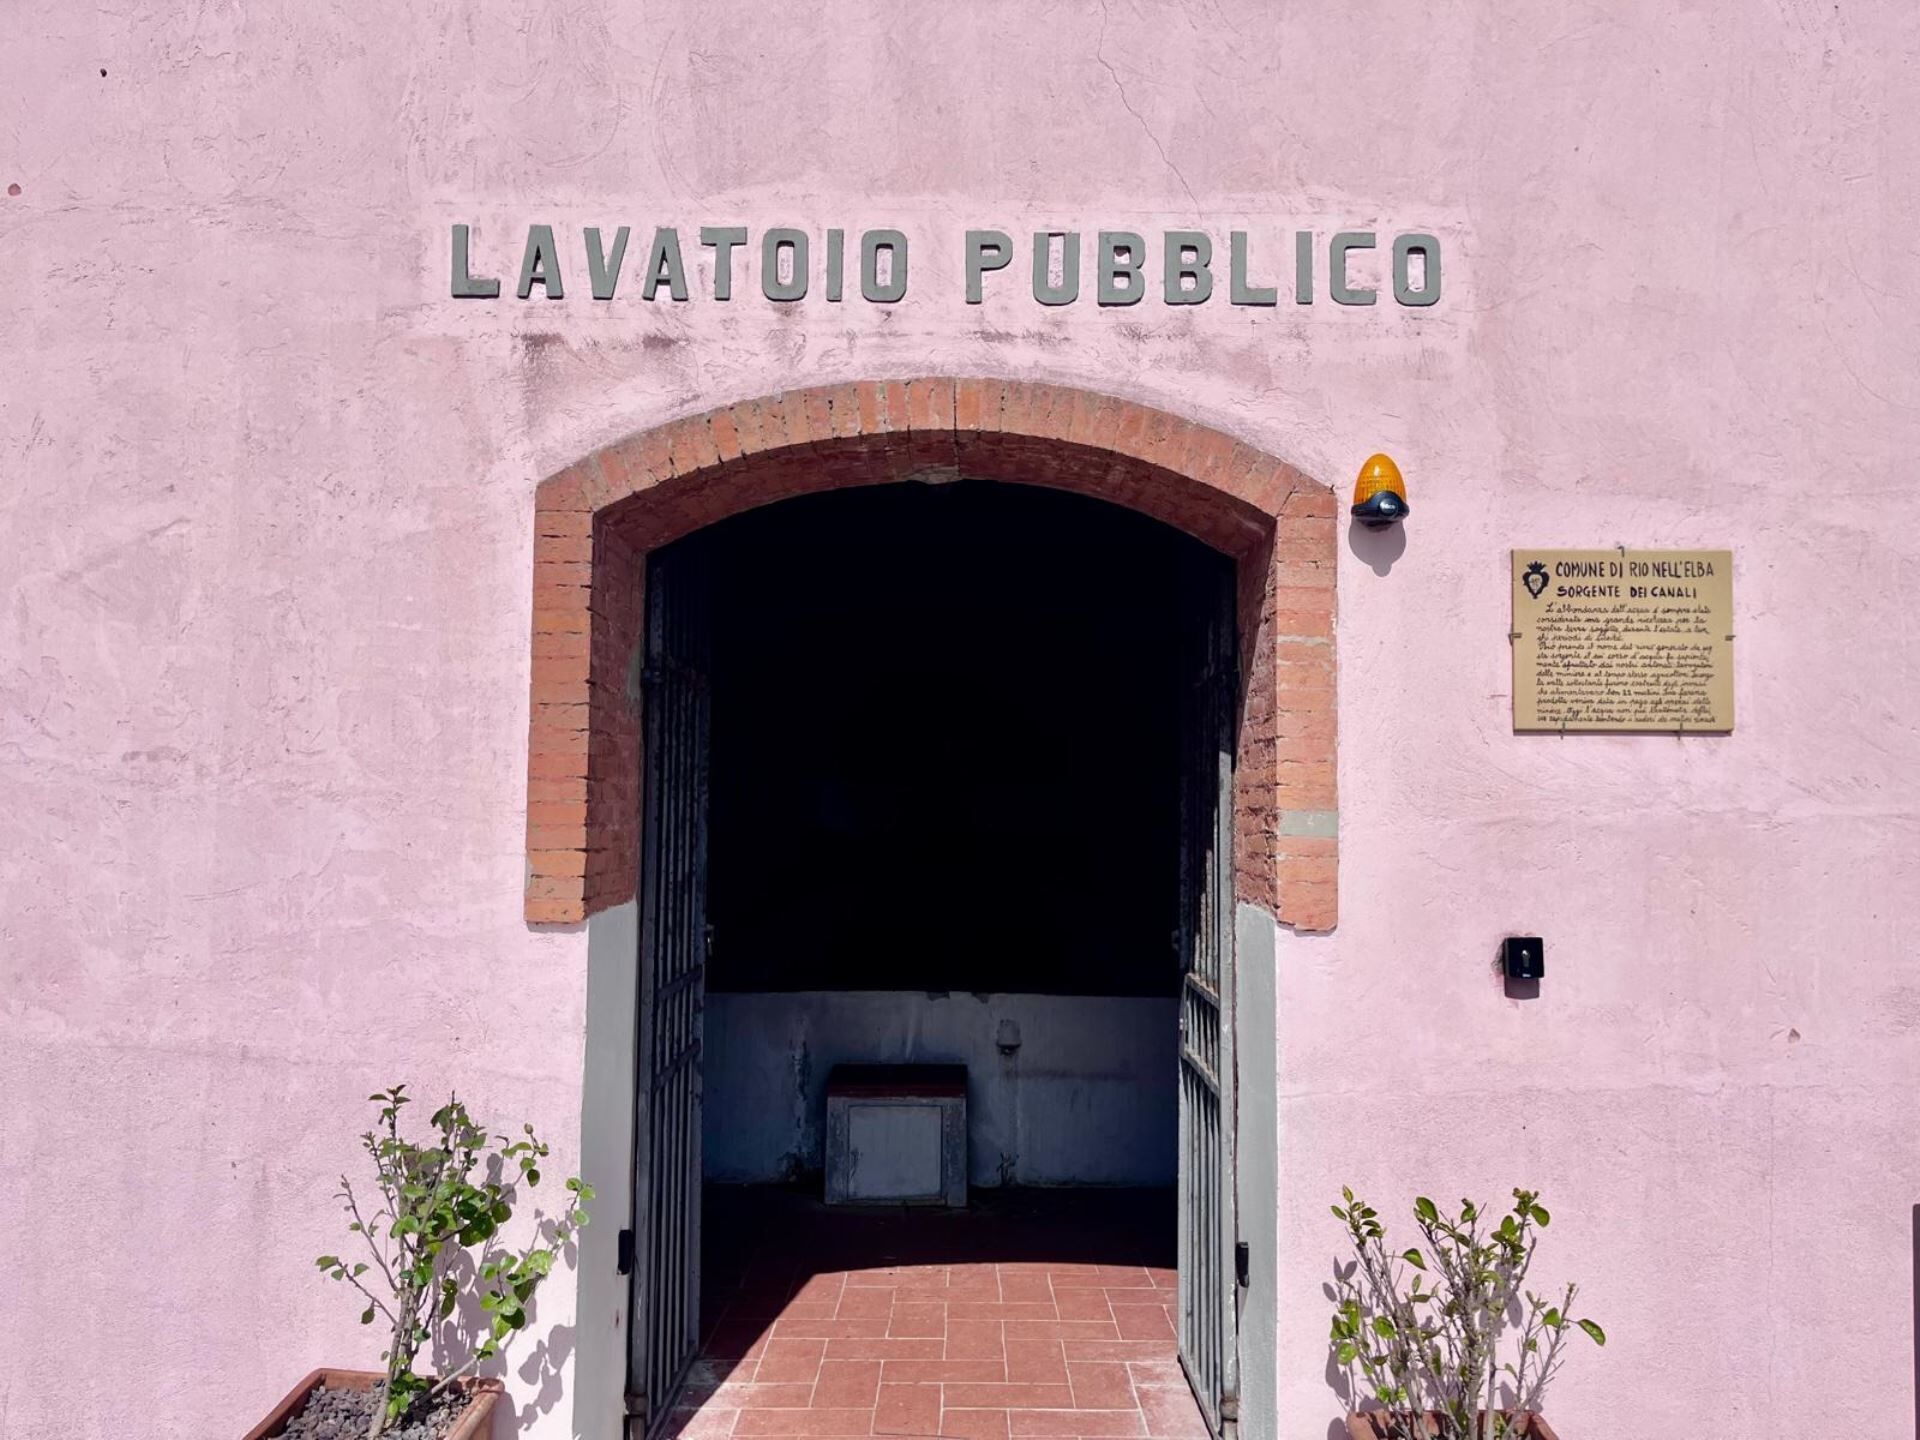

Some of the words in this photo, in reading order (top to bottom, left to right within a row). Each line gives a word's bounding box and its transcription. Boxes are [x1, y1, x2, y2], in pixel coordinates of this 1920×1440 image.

[451, 224, 908, 302] LAVATOIO
[965, 230, 1442, 307] PUBBLICO
[1555, 561, 1605, 578] COMUNE
[1609, 562, 1624, 578] DI
[1629, 562, 1649, 577] RIO
[1652, 561, 1714, 578] NELL'ELBA
[1557, 585, 1620, 597] SORGENTE
[1630, 586, 1647, 598] DEI
[1651, 586, 1697, 598] CANALI
